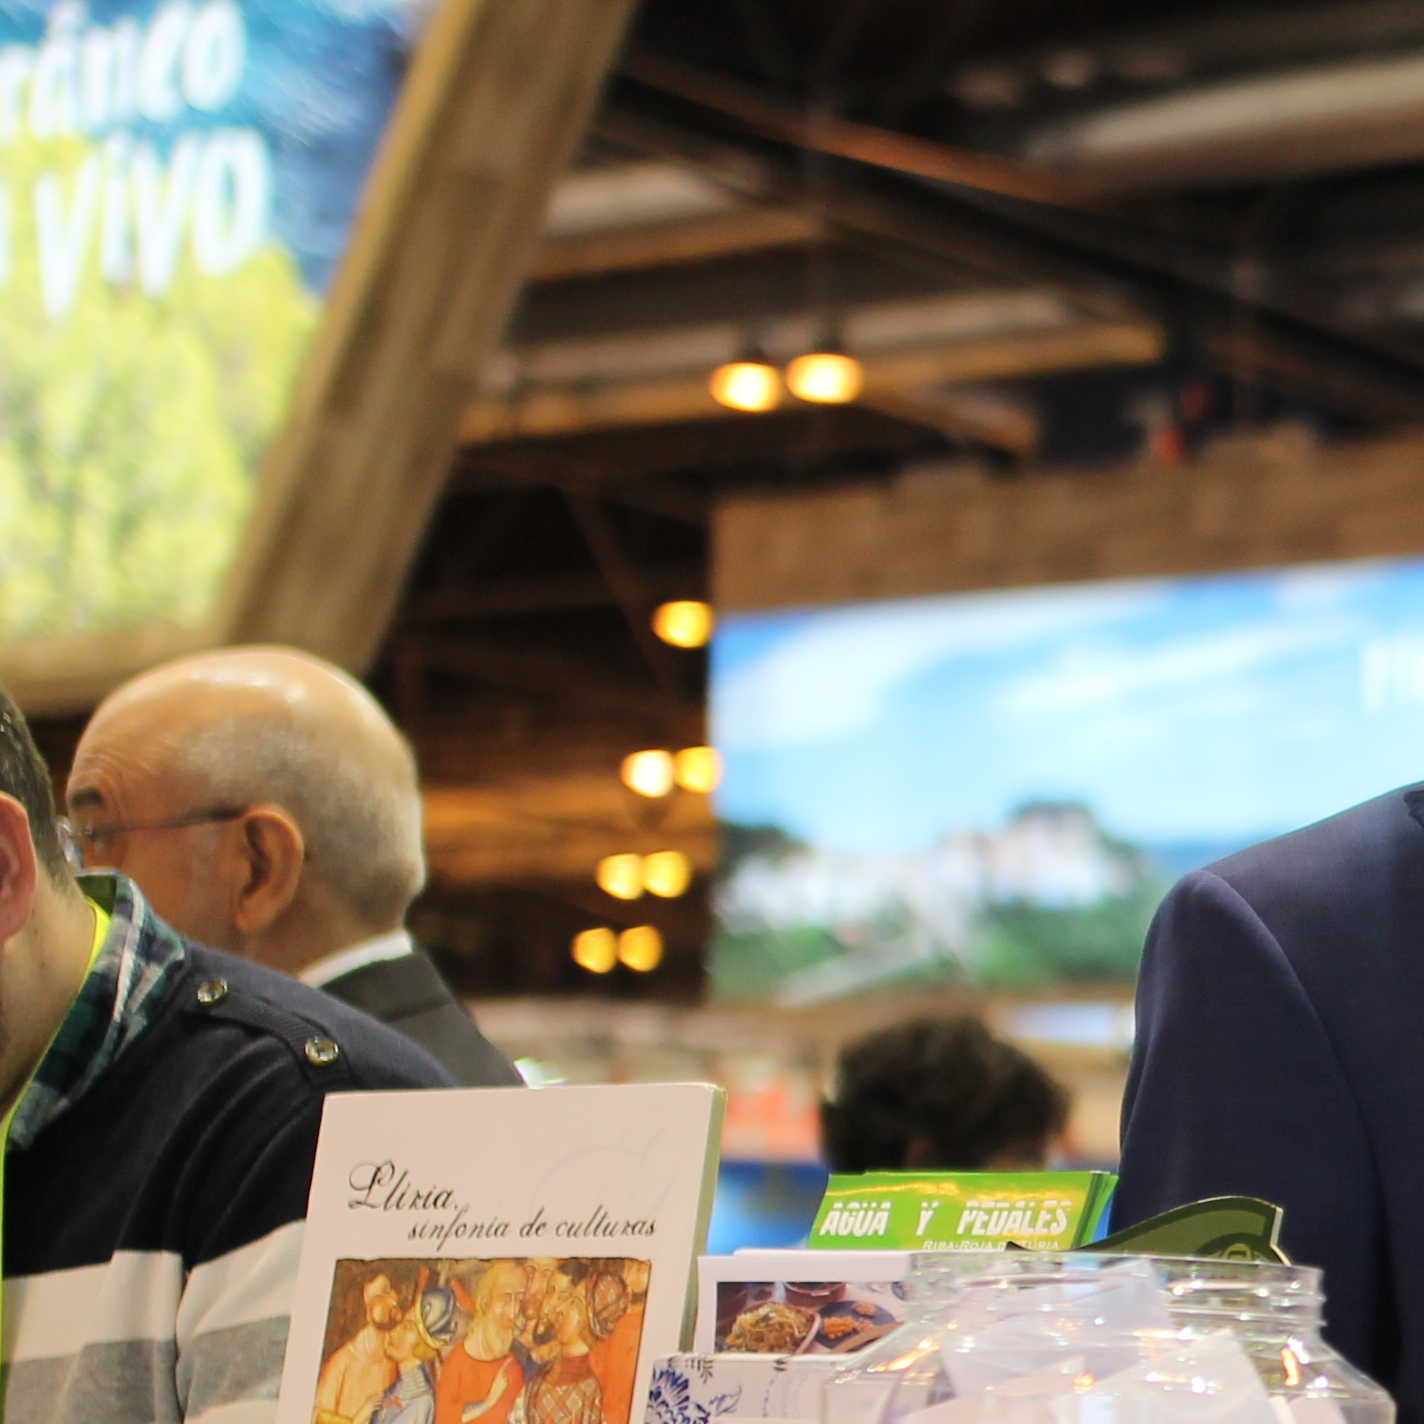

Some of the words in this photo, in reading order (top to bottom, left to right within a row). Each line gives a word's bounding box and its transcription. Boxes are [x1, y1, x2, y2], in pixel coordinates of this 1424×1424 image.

[519, 1208, 547, 1238] de
[555, 1204, 656, 1238] culturas
[916, 1200, 940, 1236] Y
